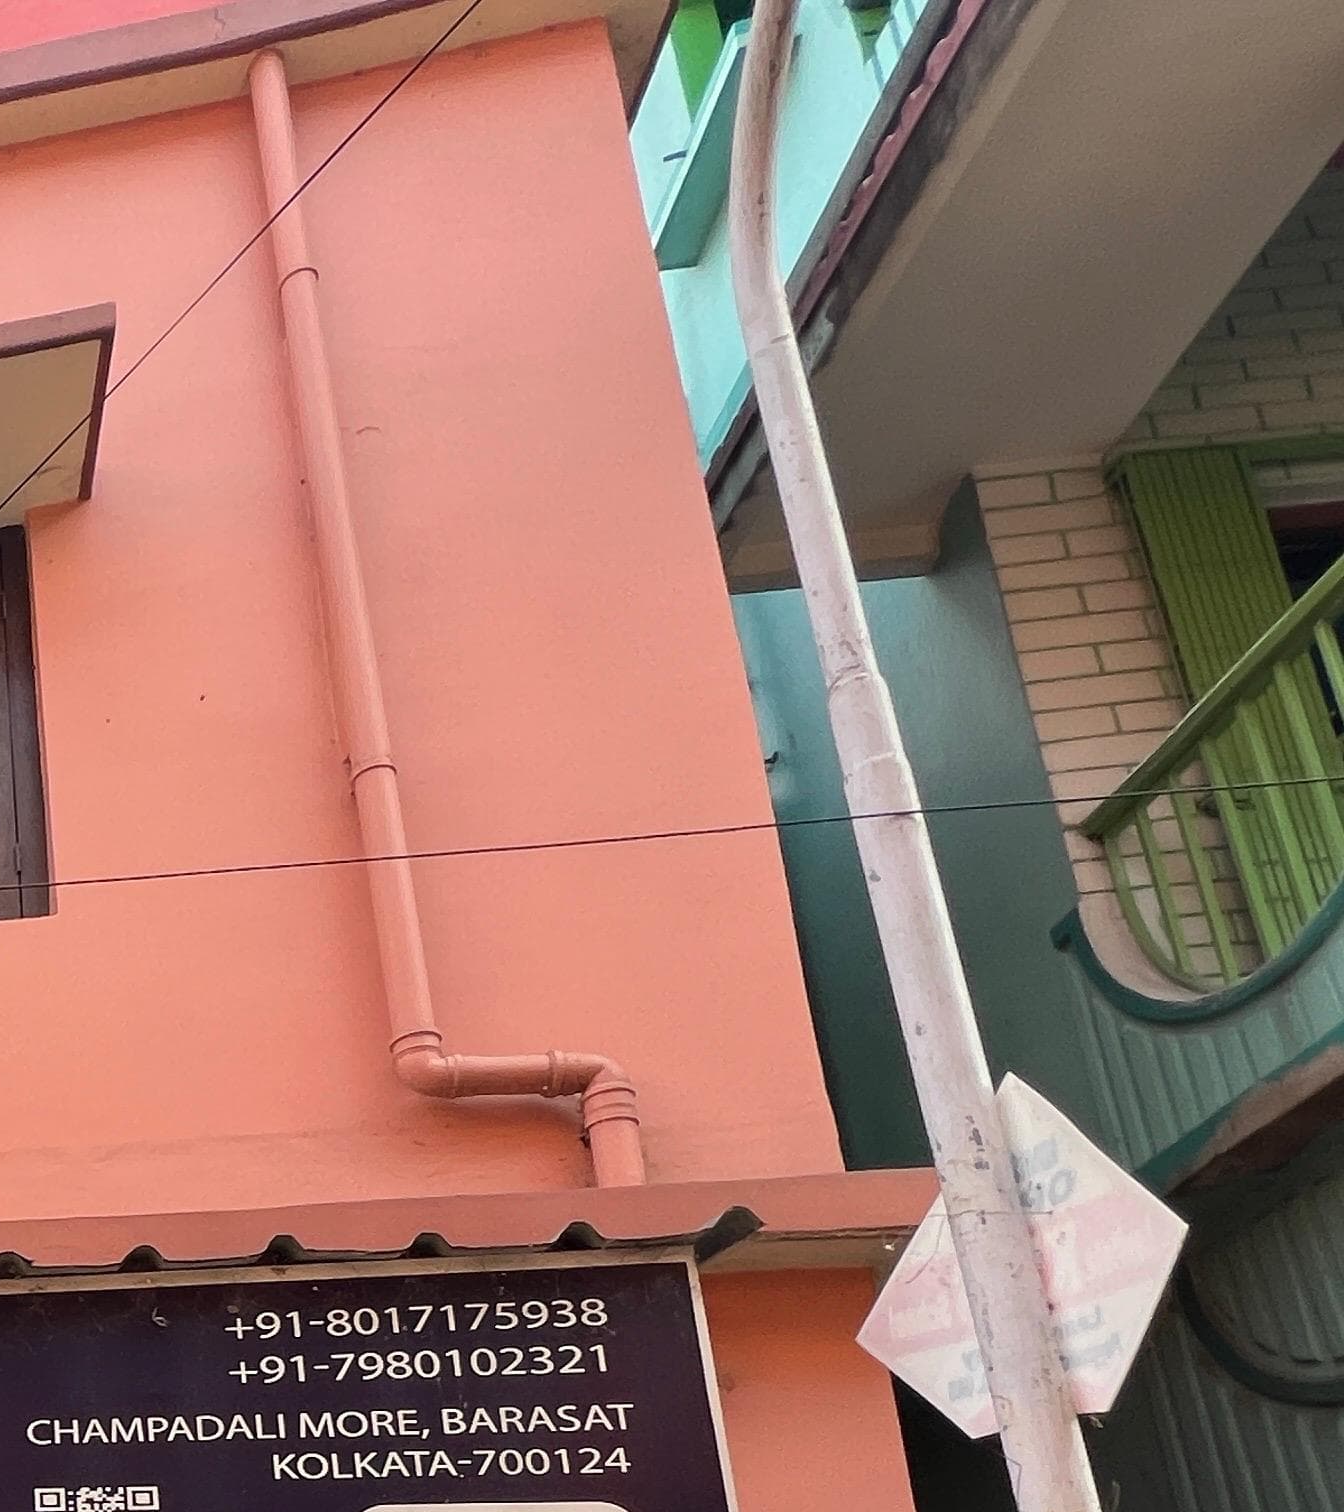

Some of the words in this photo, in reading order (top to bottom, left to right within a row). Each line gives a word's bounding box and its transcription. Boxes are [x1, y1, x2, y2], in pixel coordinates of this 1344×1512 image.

[224, 1298, 608, 1342] +91-8017175938
[228, 1345, 609, 1386] +91-7980102321
[26, 1413, 287, 1446] CHAMPADALI
[298, 1409, 432, 1441] MORE,
[441, 1404, 634, 1436] BARASAT
[272, 1447, 631, 1481] KOLKATA-700124
